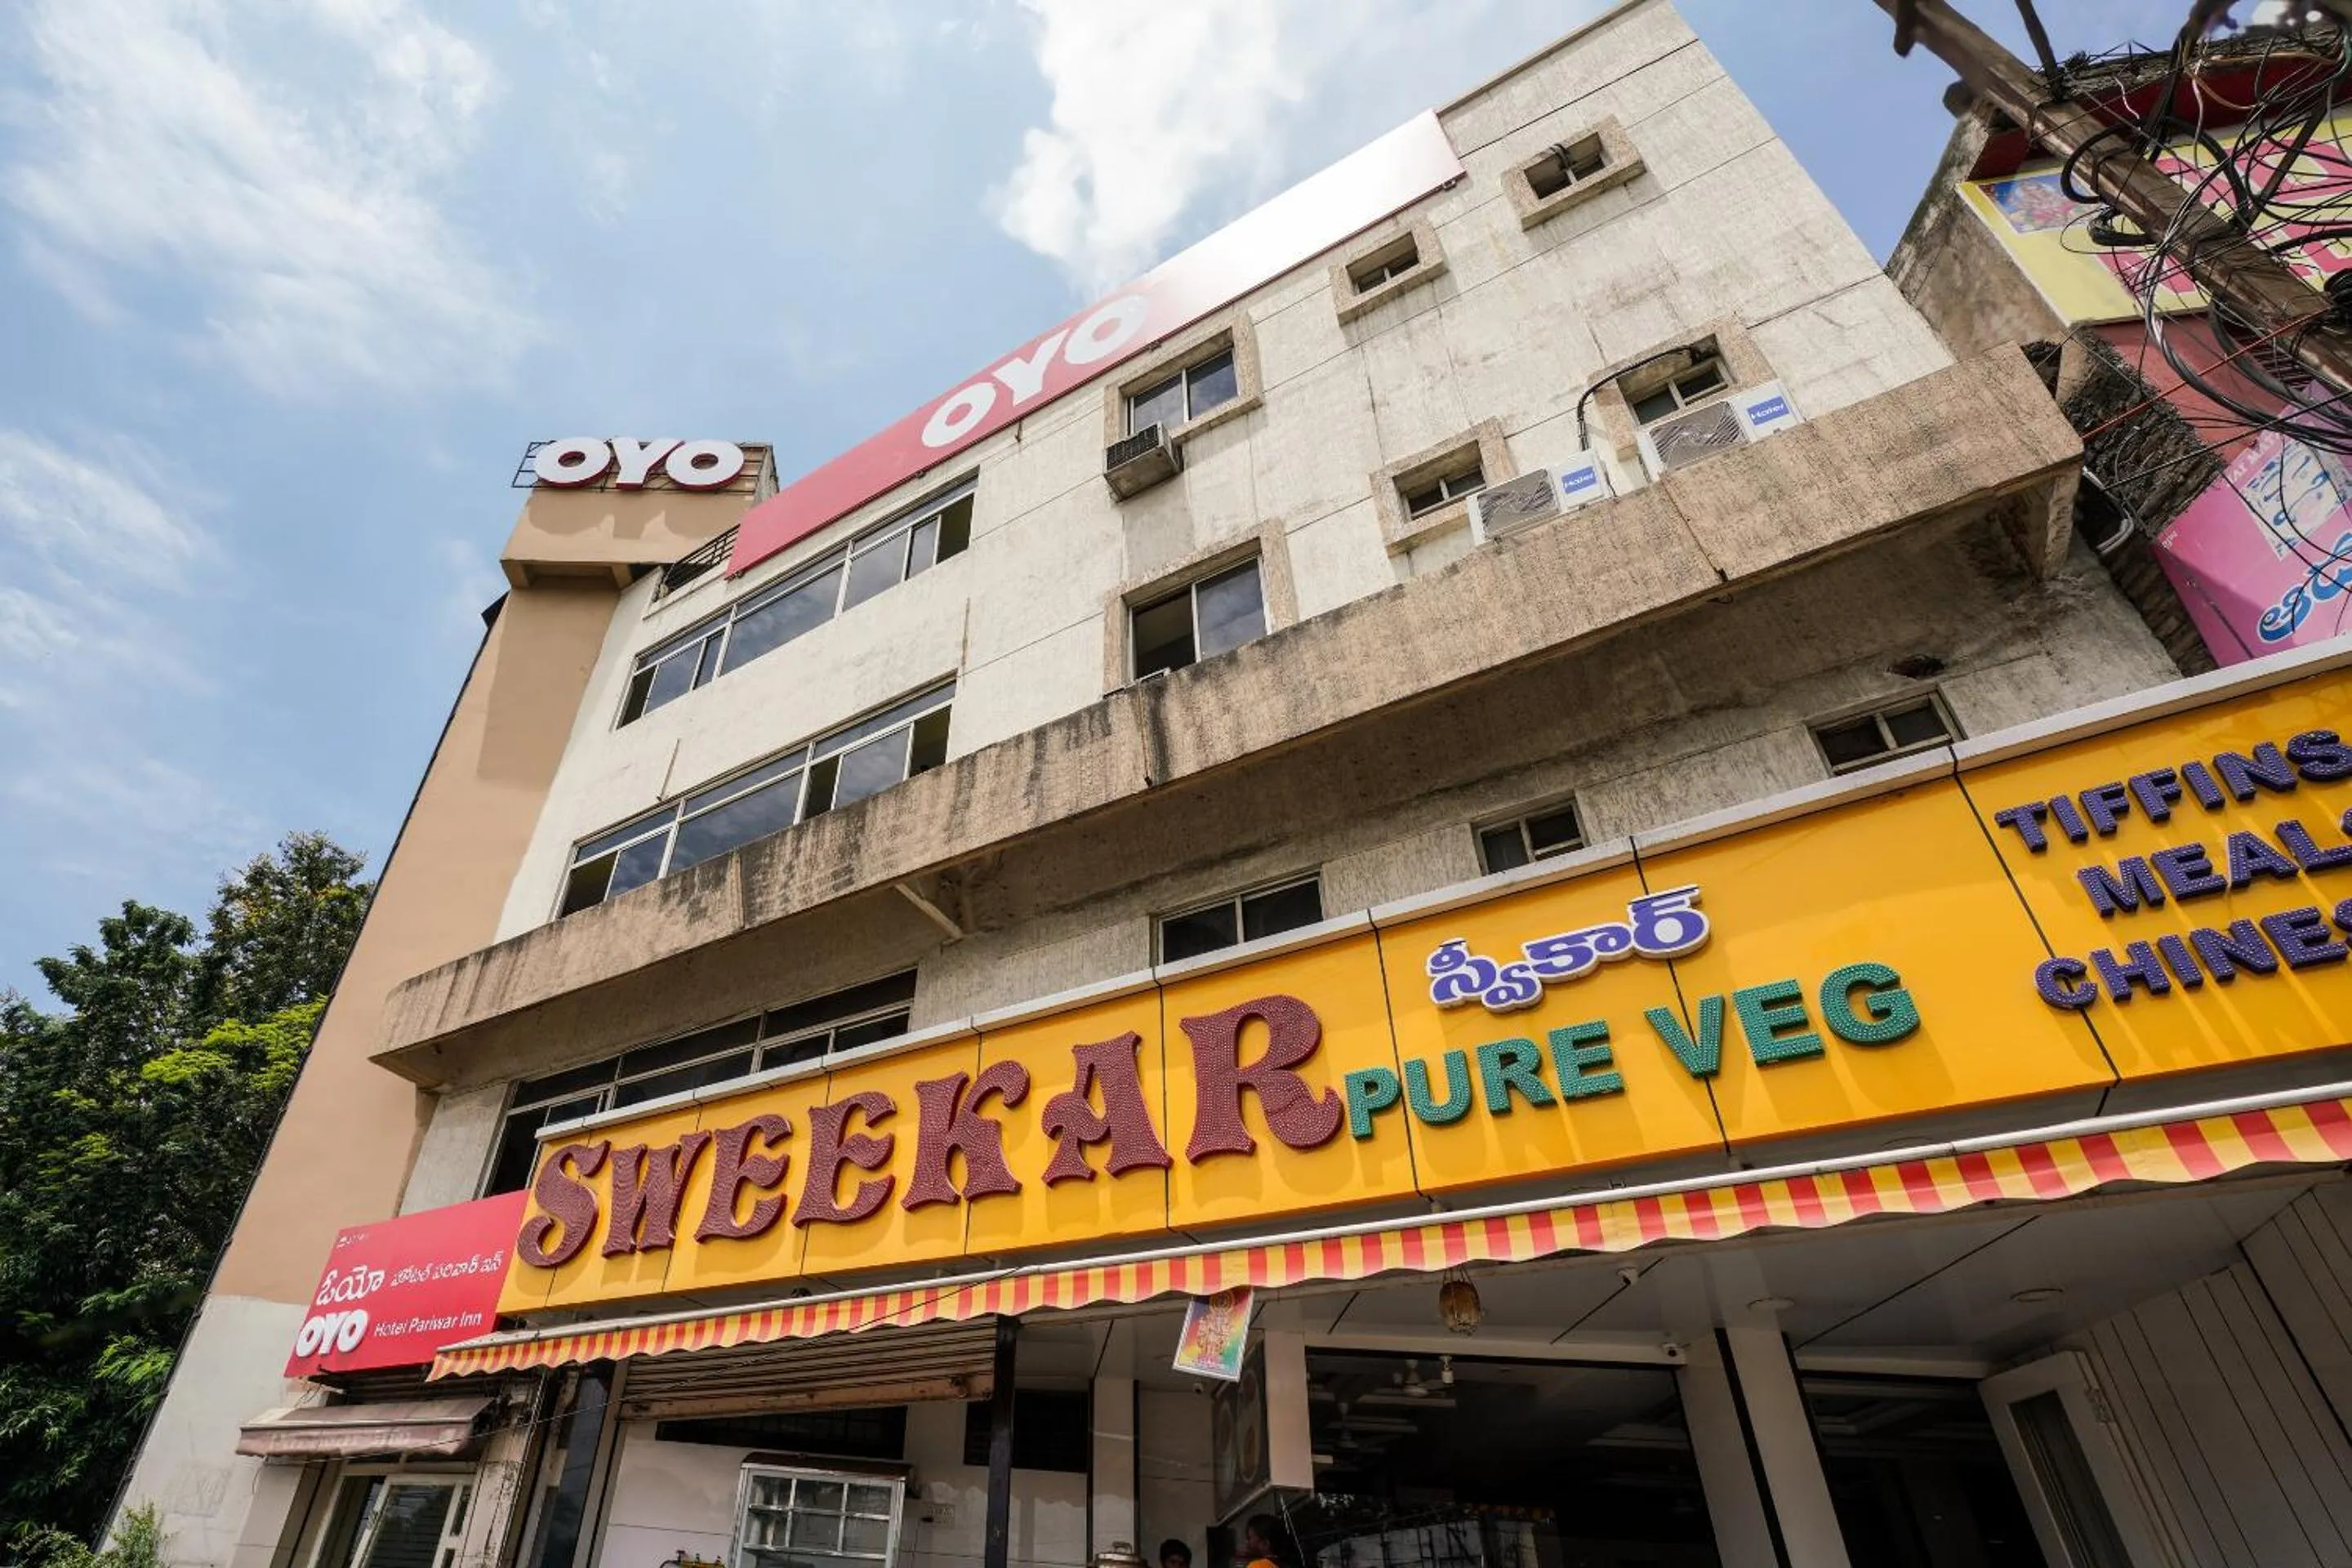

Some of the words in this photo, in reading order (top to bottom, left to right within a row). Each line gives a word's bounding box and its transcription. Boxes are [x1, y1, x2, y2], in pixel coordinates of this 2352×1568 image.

[921, 294, 1145, 448] OYO
[535, 436, 745, 489] OYO
[1994, 730, 2352, 853] TIFFINS
[2078, 807, 2352, 917] MEAL
[1344, 1019, 1625, 1140] PURE
[1643, 961, 1921, 1081] VEG
[518, 994, 1343, 1269] SWEEKAR
[295, 1308, 369, 1358] OYO
[373, 1321, 408, 1337] Hotel
[408, 1315, 459, 1333] Pariwar
[460, 1311, 483, 1326] Inn
